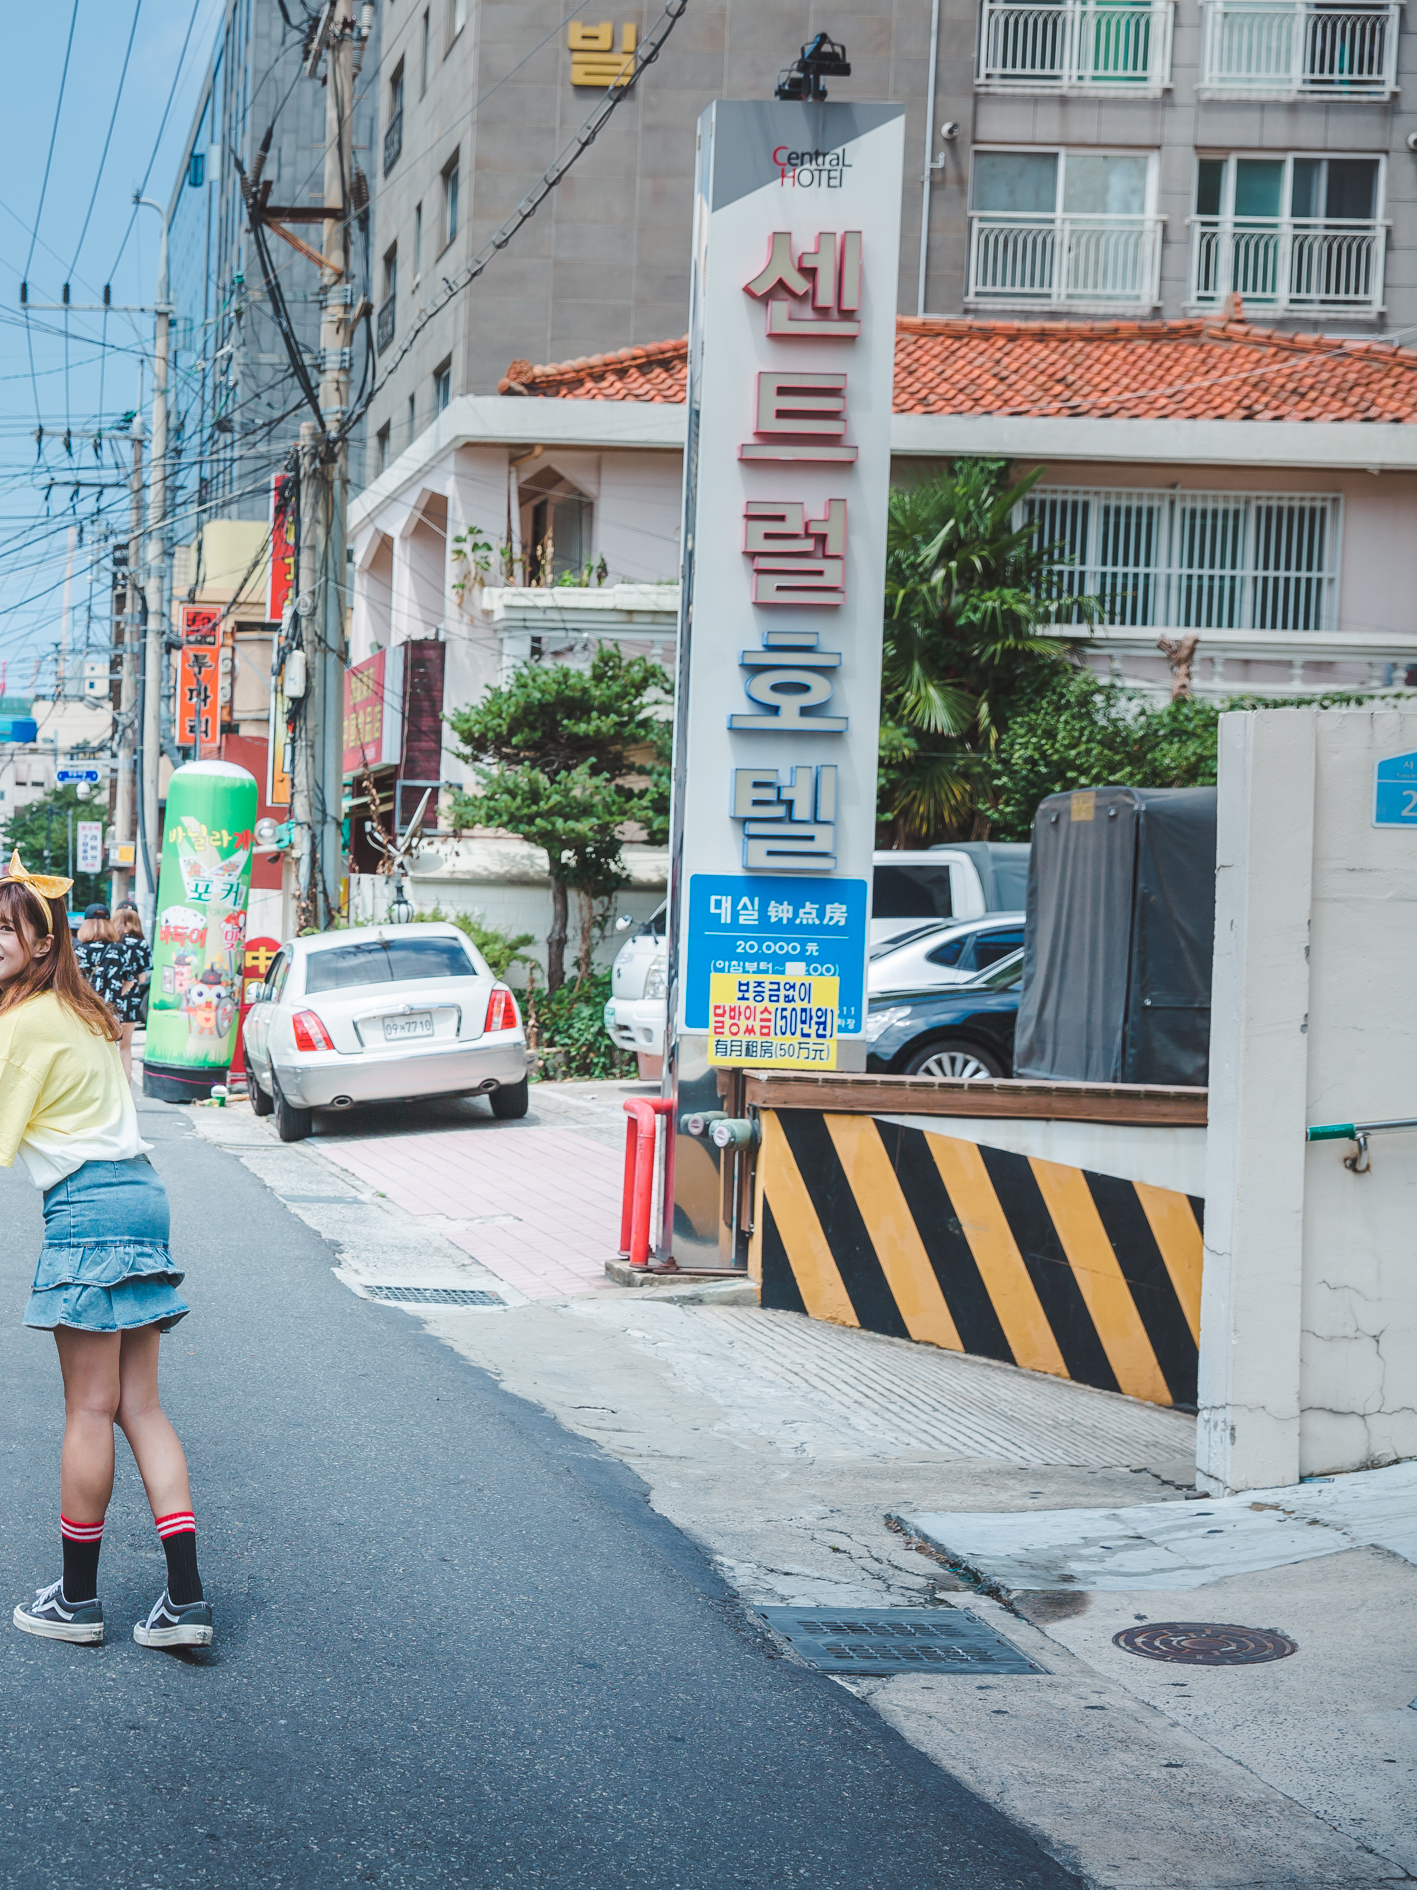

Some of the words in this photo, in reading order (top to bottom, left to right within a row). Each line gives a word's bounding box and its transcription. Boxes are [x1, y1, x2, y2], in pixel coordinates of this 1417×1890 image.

[186, 878, 240, 907] 포커
[710, 895, 760, 925] 대실
[767, 900, 849, 926] 钟点房
[736, 941, 800, 954] 20.000
[805, 943, 819, 955] 元
[737, 980, 812, 1004] 보증금없이
